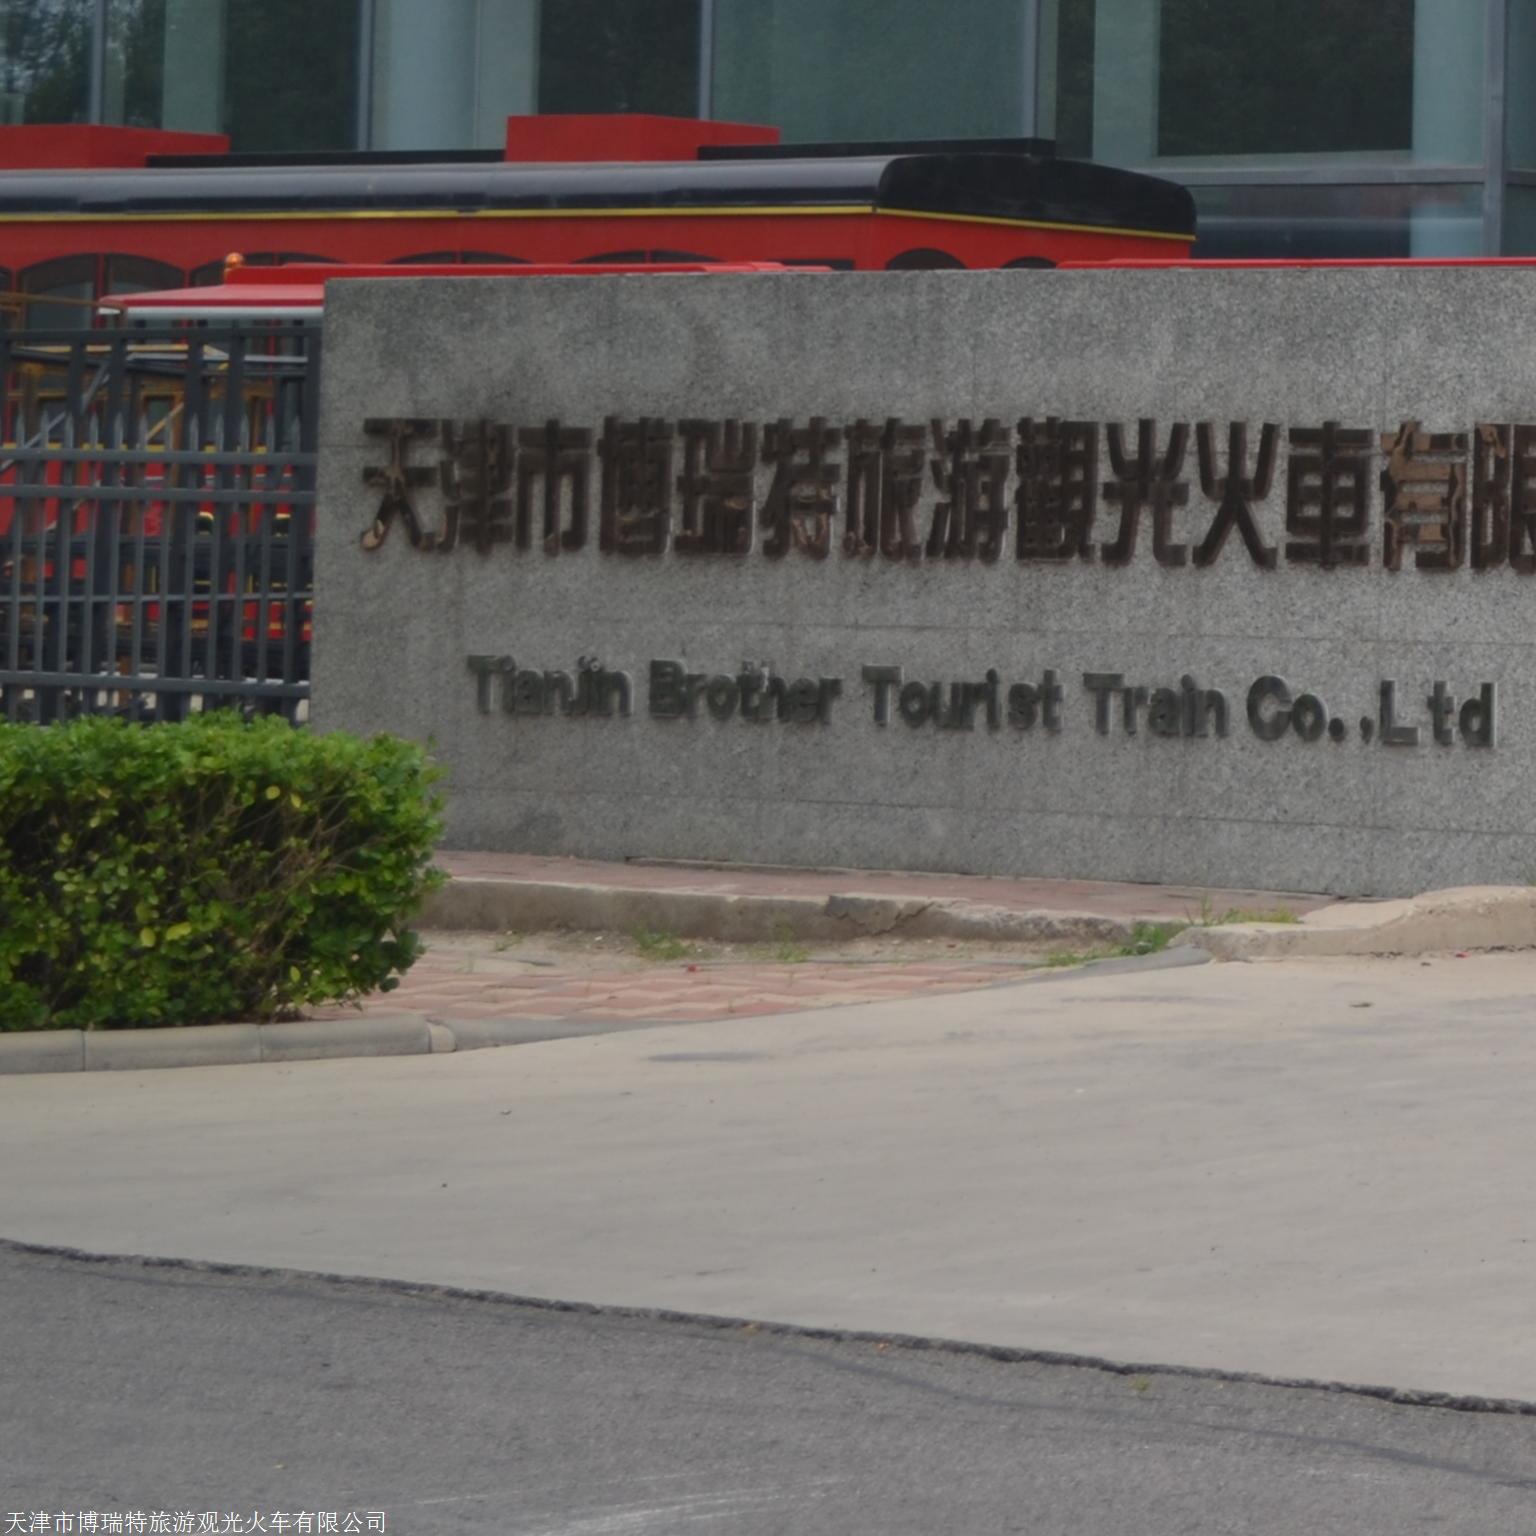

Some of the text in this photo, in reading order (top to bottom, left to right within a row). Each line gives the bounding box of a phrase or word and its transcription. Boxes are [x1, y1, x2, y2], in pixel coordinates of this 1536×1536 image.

[467, 653, 634, 717] Tianjin
[648, 657, 844, 727] Brother
[861, 664, 1063, 733] Tourist
[1082, 671, 1231, 738] Train
